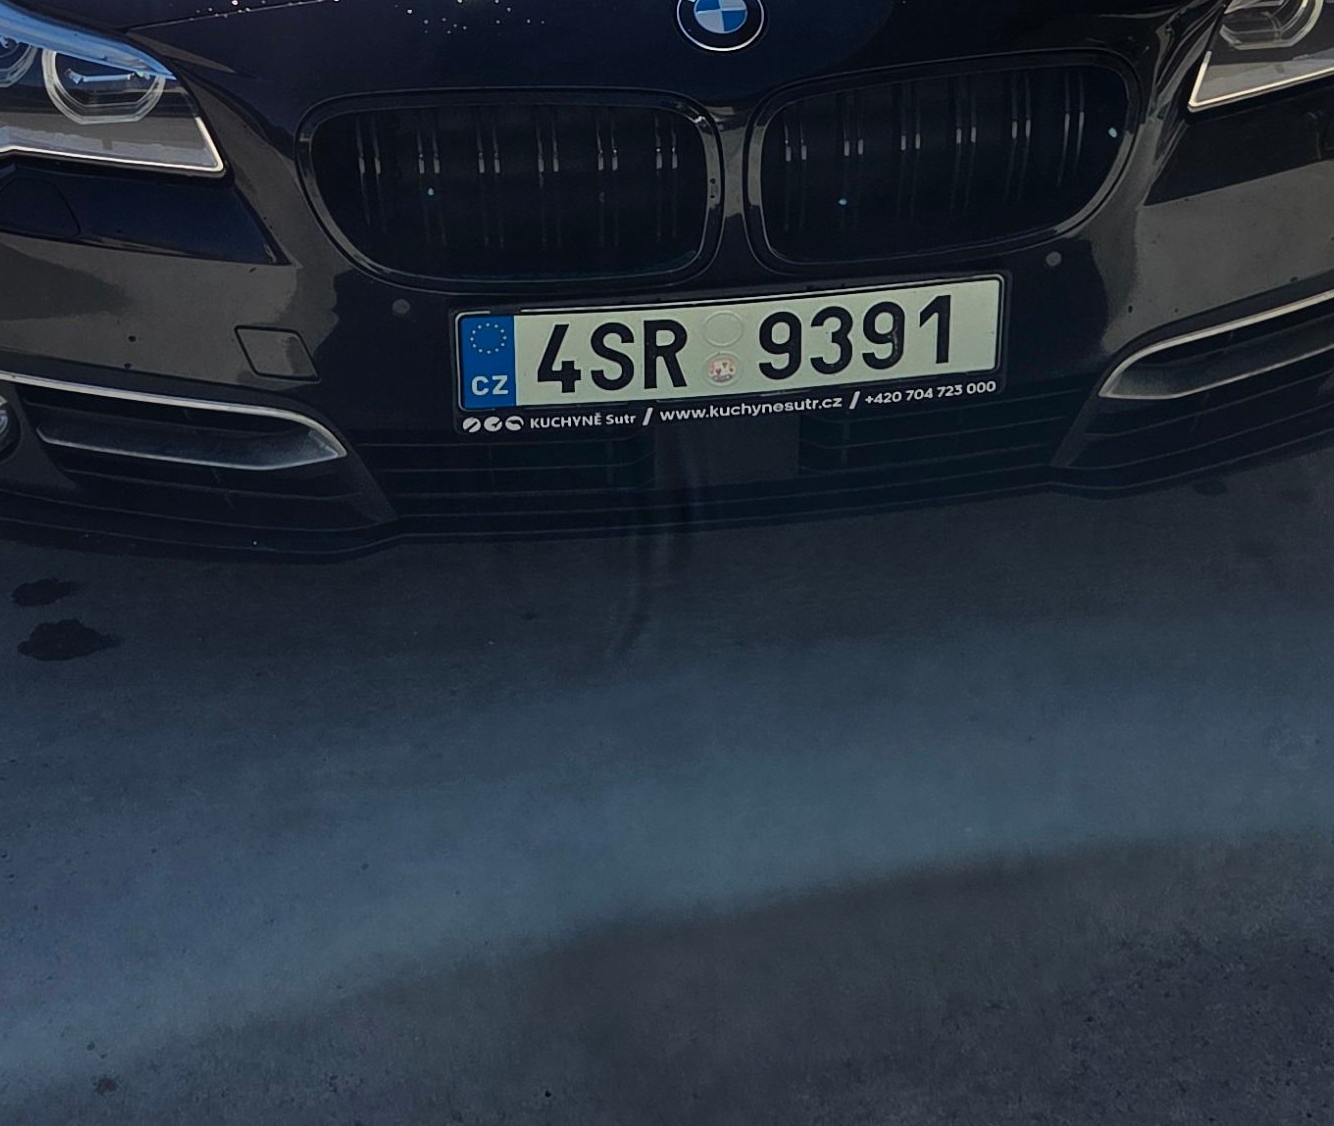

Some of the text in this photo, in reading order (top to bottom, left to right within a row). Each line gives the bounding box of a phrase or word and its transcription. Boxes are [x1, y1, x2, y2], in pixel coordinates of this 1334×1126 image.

[537, 295, 952, 394] 4SR 9391
[471, 375, 509, 396] CZ
[530, 412, 602, 429] KUCHYNĚ
[606, 414, 637, 425] Sutr
[660, 396, 843, 421] www.kuchynesutr.cz
[865, 391, 902, 404] +420
[906, 387, 933, 401] 704
[937, 384, 963, 398] 723
[967, 380, 996, 394] 000
